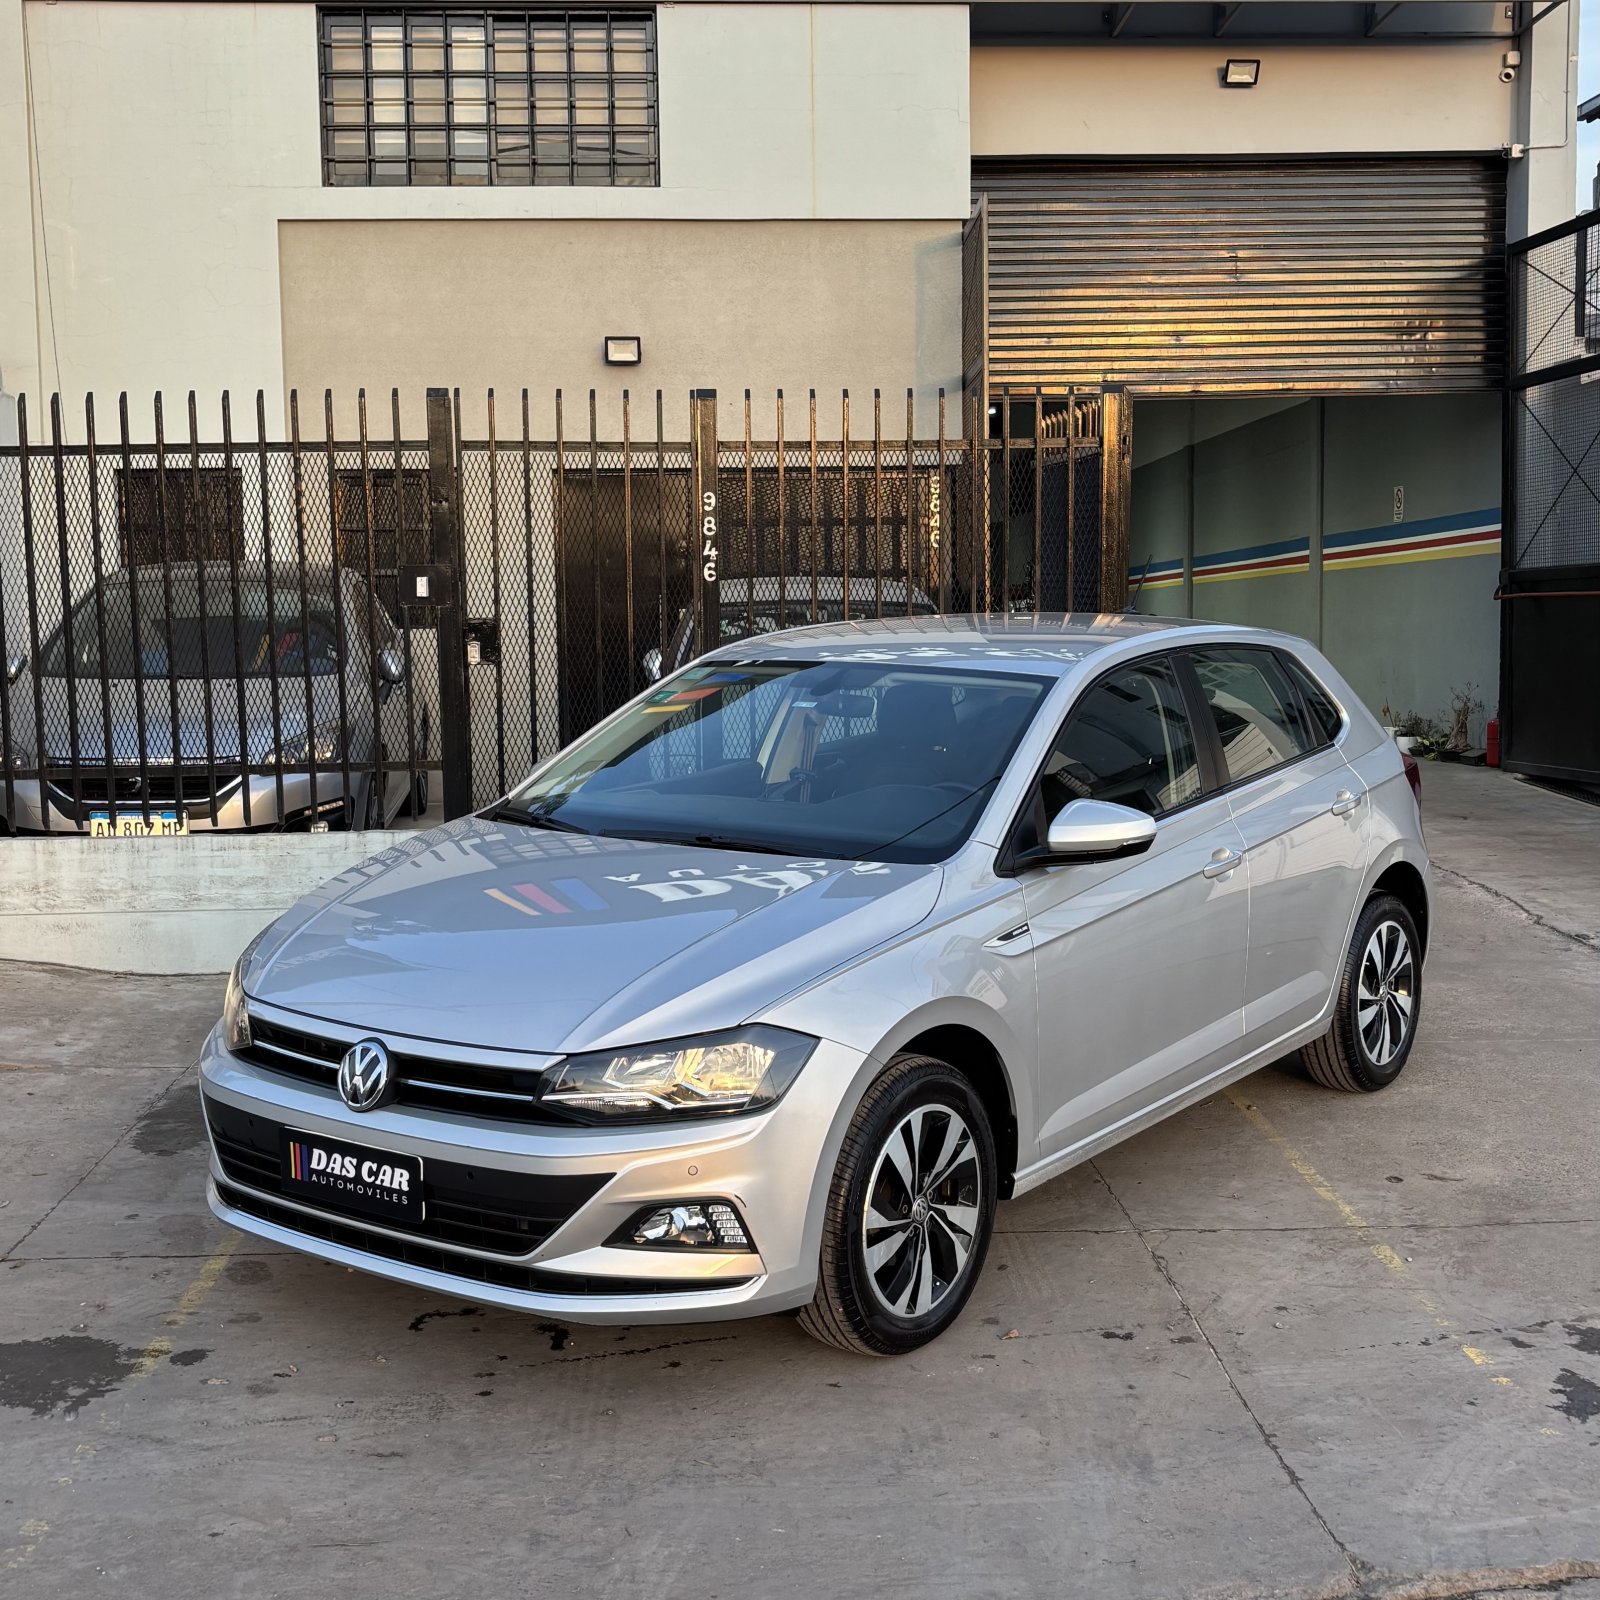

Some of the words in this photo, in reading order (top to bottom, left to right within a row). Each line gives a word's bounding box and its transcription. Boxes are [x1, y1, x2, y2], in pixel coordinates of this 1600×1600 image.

[702, 491, 718, 582] 9846
[310, 1148, 357, 1178] DAS
[361, 1160, 410, 1191] CAR
[311, 1173, 408, 1205] AUTOMOVILES
